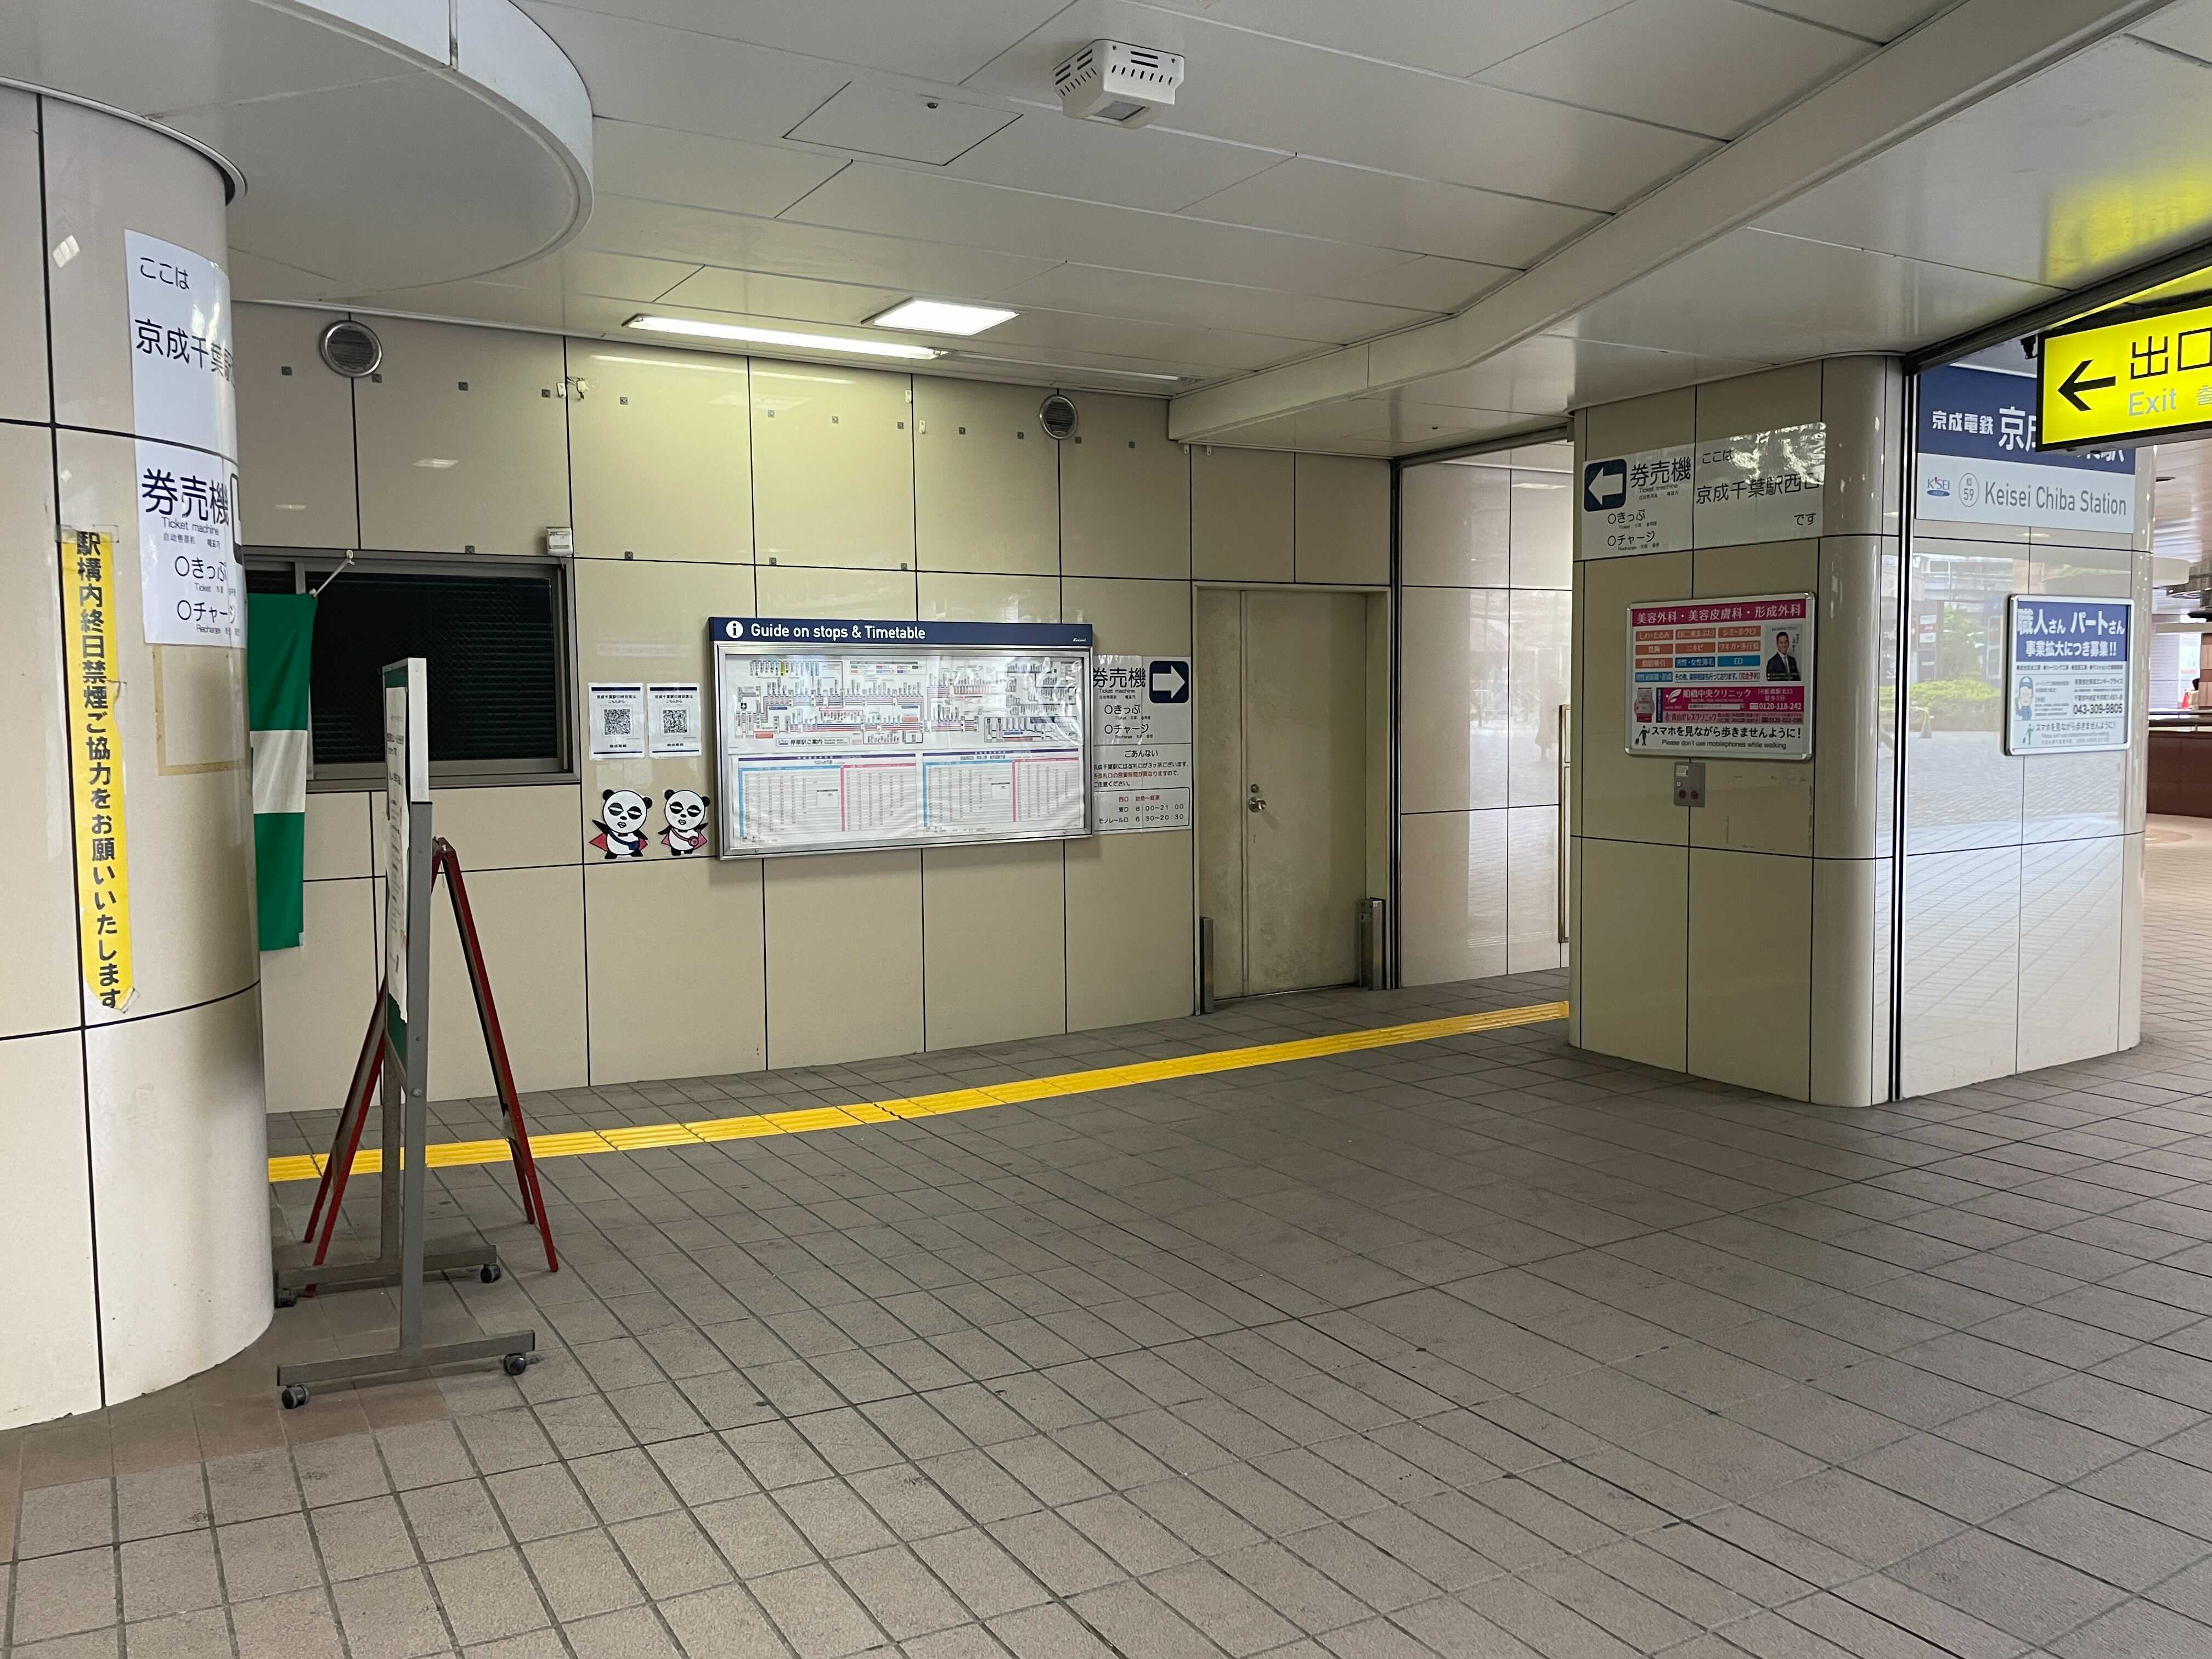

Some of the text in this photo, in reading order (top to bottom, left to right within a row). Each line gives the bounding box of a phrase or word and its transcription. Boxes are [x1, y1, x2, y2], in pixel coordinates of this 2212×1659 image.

[140, 257, 189, 290] ここは
[2130, 327, 2212, 380] 出口
[2129, 387, 2177, 416] Exit
[1932, 410, 1994, 436] 京成電鉄
[1630, 456, 1691, 488] 券売機
[142, 468, 229, 526] 券売機
[1963, 488, 1974, 501] 59
[1985, 481, 2126, 516] Keisei Chiba Station
[161, 517, 219, 535] Ticket machine
[1793, 512, 1816, 526] です
[751, 623, 926, 641] Guide on stops & Timetable
[2017, 608, 2125, 635] 職人さん パートさん
[1093, 667, 1146, 689] 券売機
[1124, 750, 1158, 758] ごあんない
[1764, 742, 1787, 750] walking
[76, 531, 121, 1008] 駅構内終日禁煙ご協力をお願いいたします
